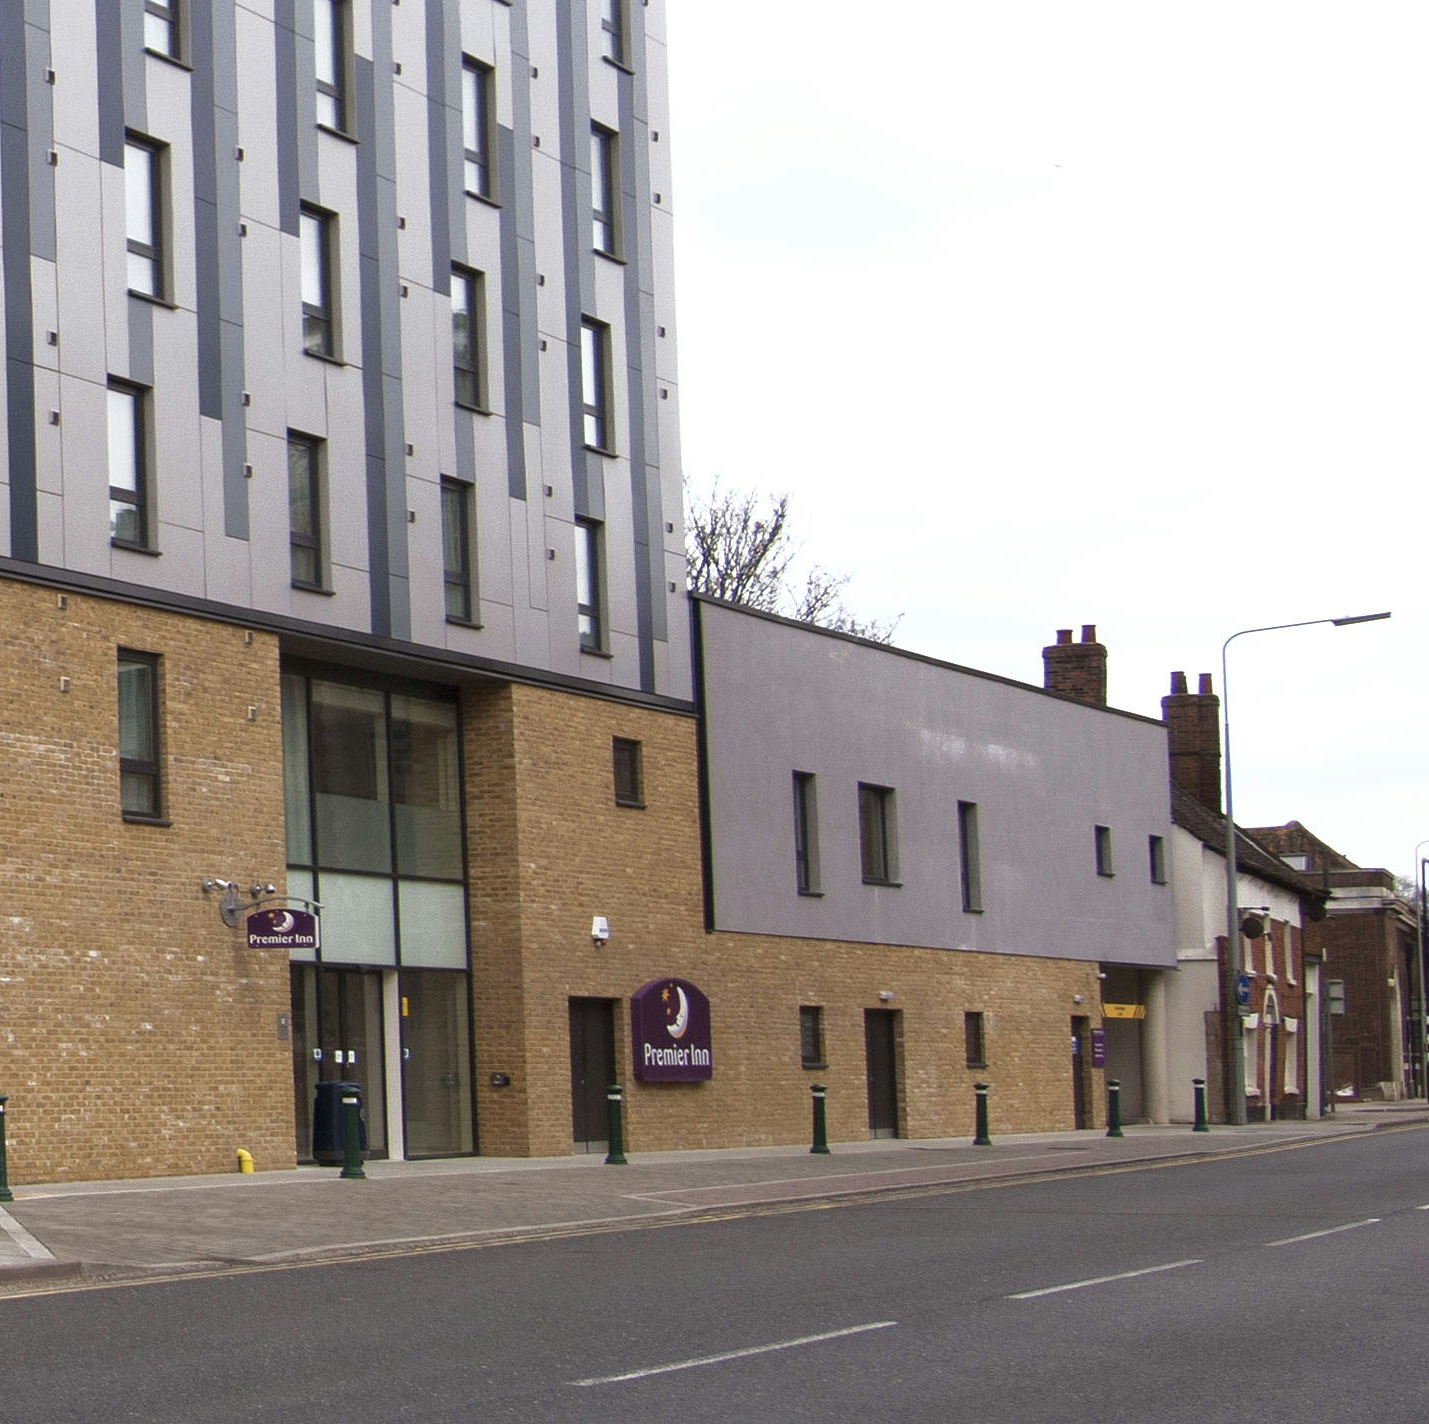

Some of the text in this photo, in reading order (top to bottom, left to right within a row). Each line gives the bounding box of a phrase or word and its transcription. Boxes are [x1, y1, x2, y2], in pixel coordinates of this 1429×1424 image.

[249, 934, 314, 944] Premier Inn
[644, 1043, 710, 1066] Premier Inn
